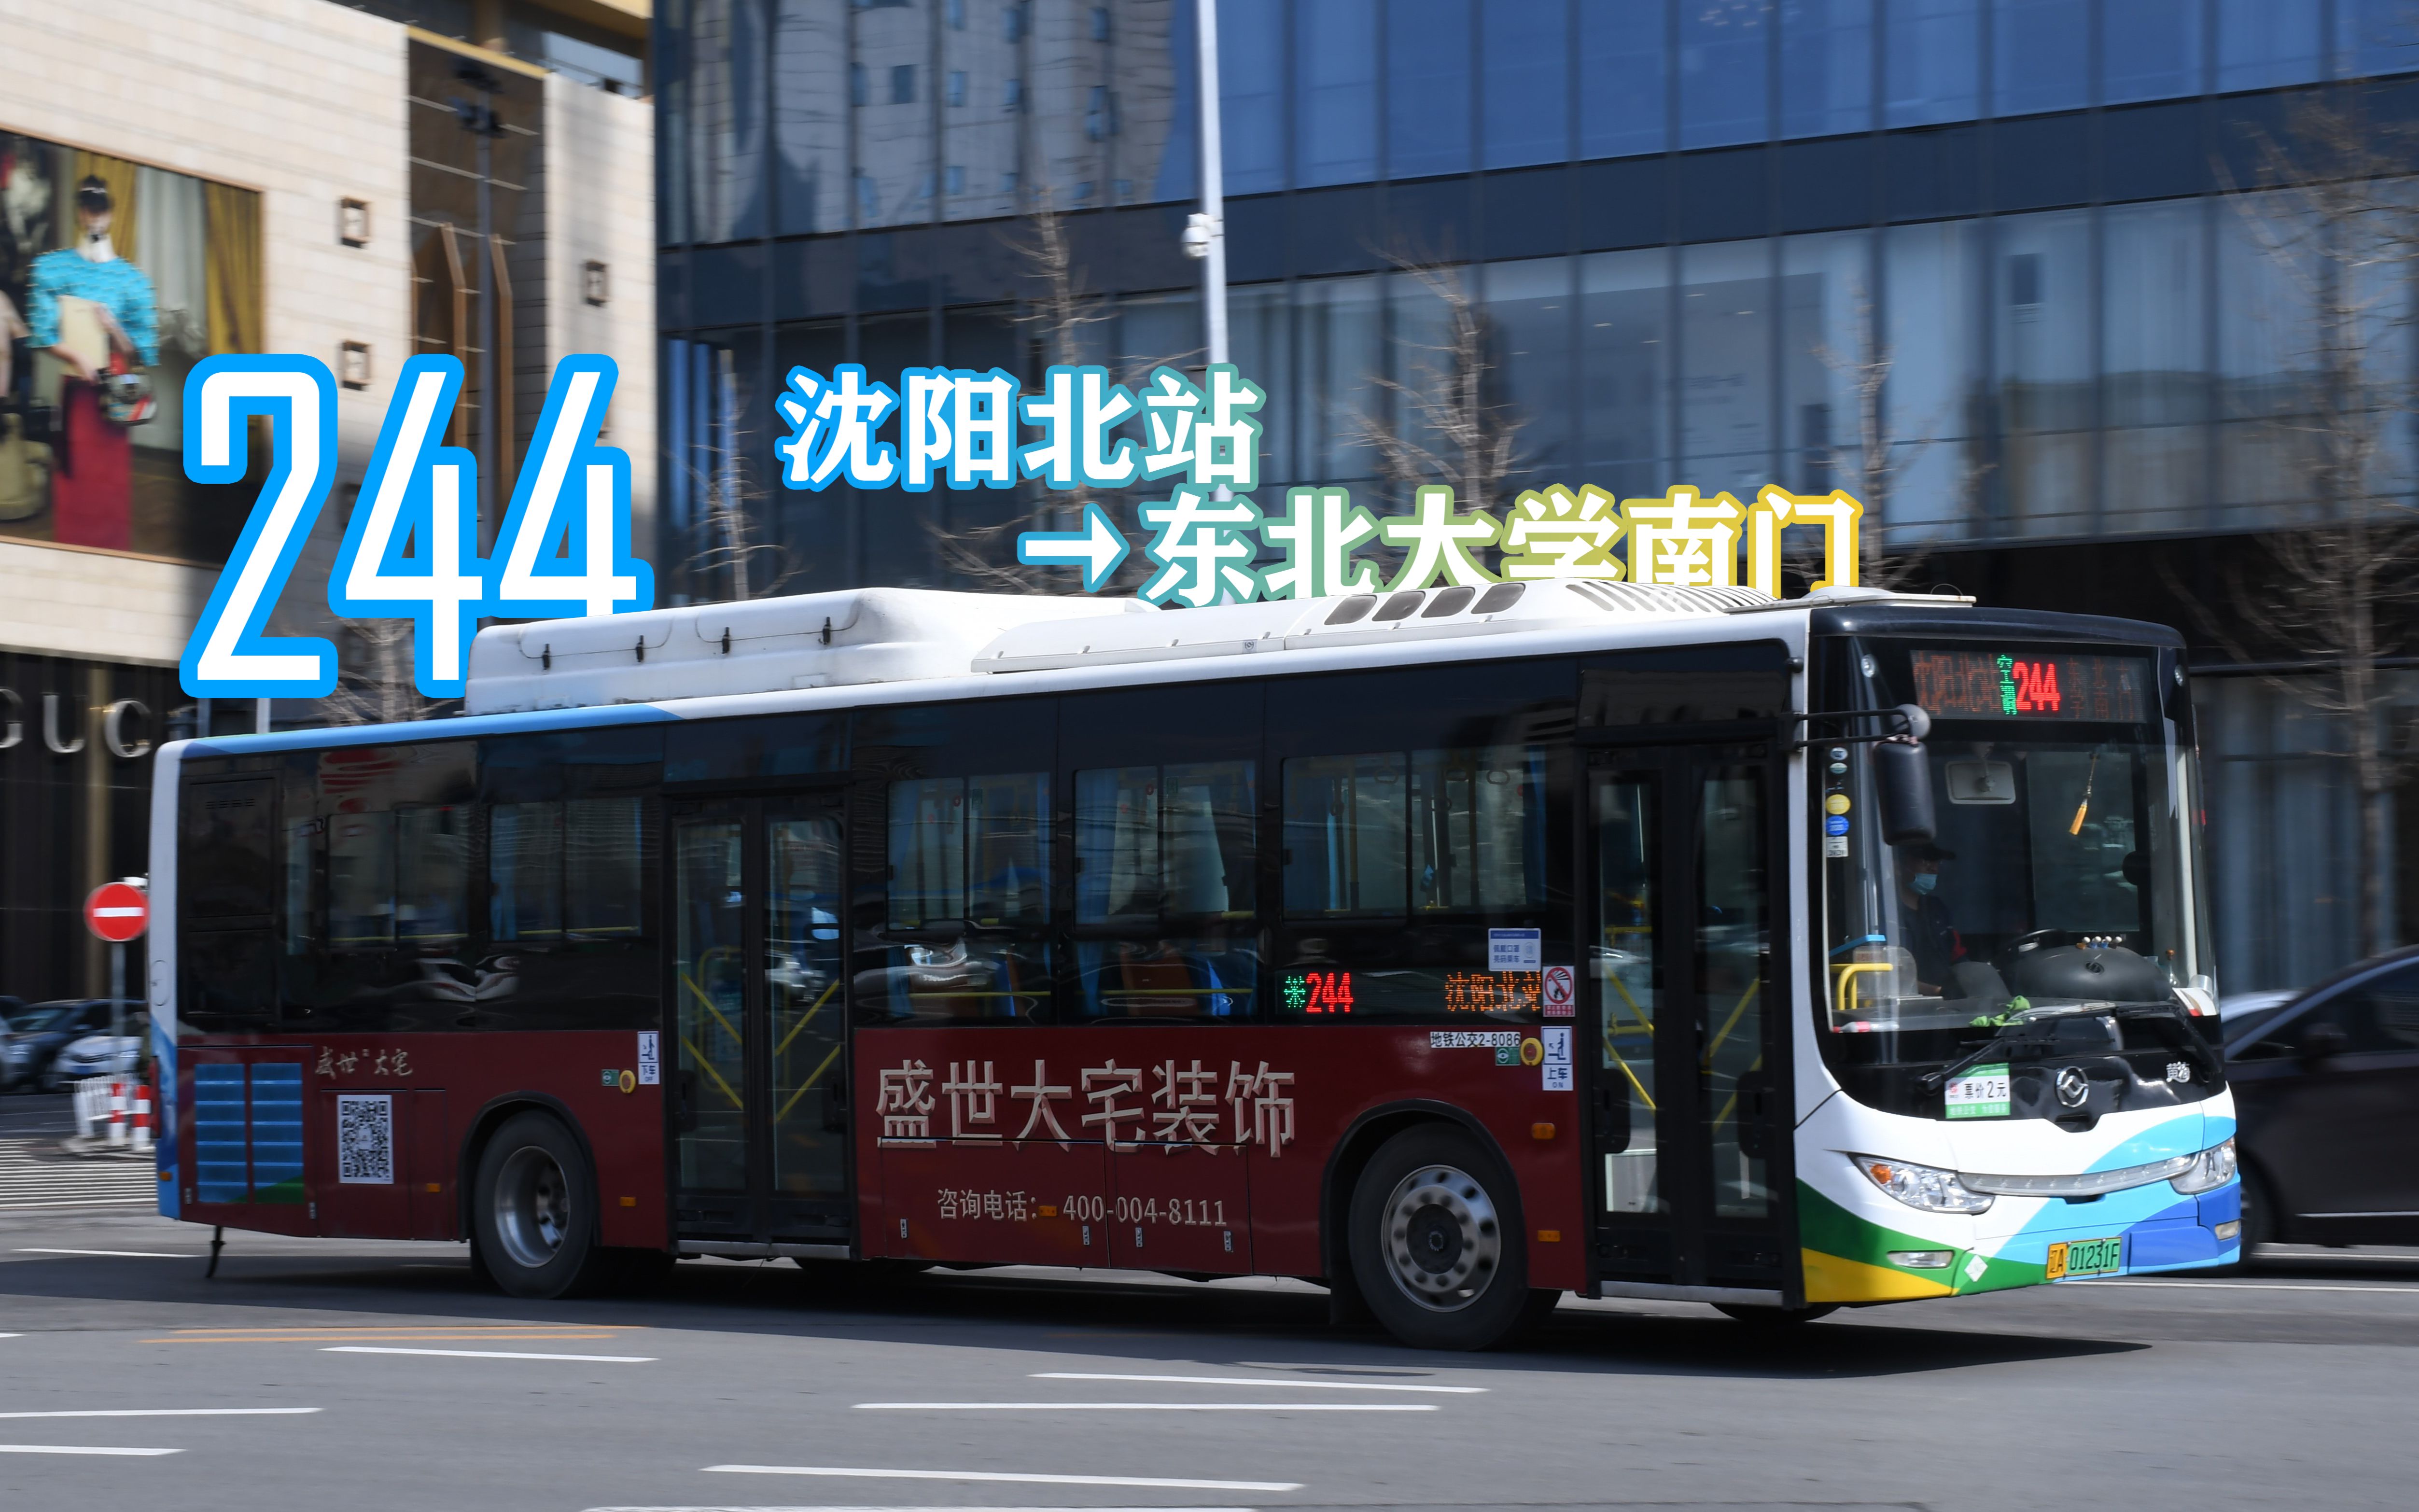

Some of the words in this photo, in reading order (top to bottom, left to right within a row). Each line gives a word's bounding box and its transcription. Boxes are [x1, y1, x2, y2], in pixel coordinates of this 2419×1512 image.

[2013, 661, 2060, 711] 244
[1305, 972, 1354, 1013] 244
[1431, 1032, 1521, 1047] 地铁公交2-8086
[1547, 1067, 1567, 1080] 上车
[875, 1058, 1295, 1158] 盛世大宅装饰
[1063, 1194, 1227, 1227] 400-004-8111
